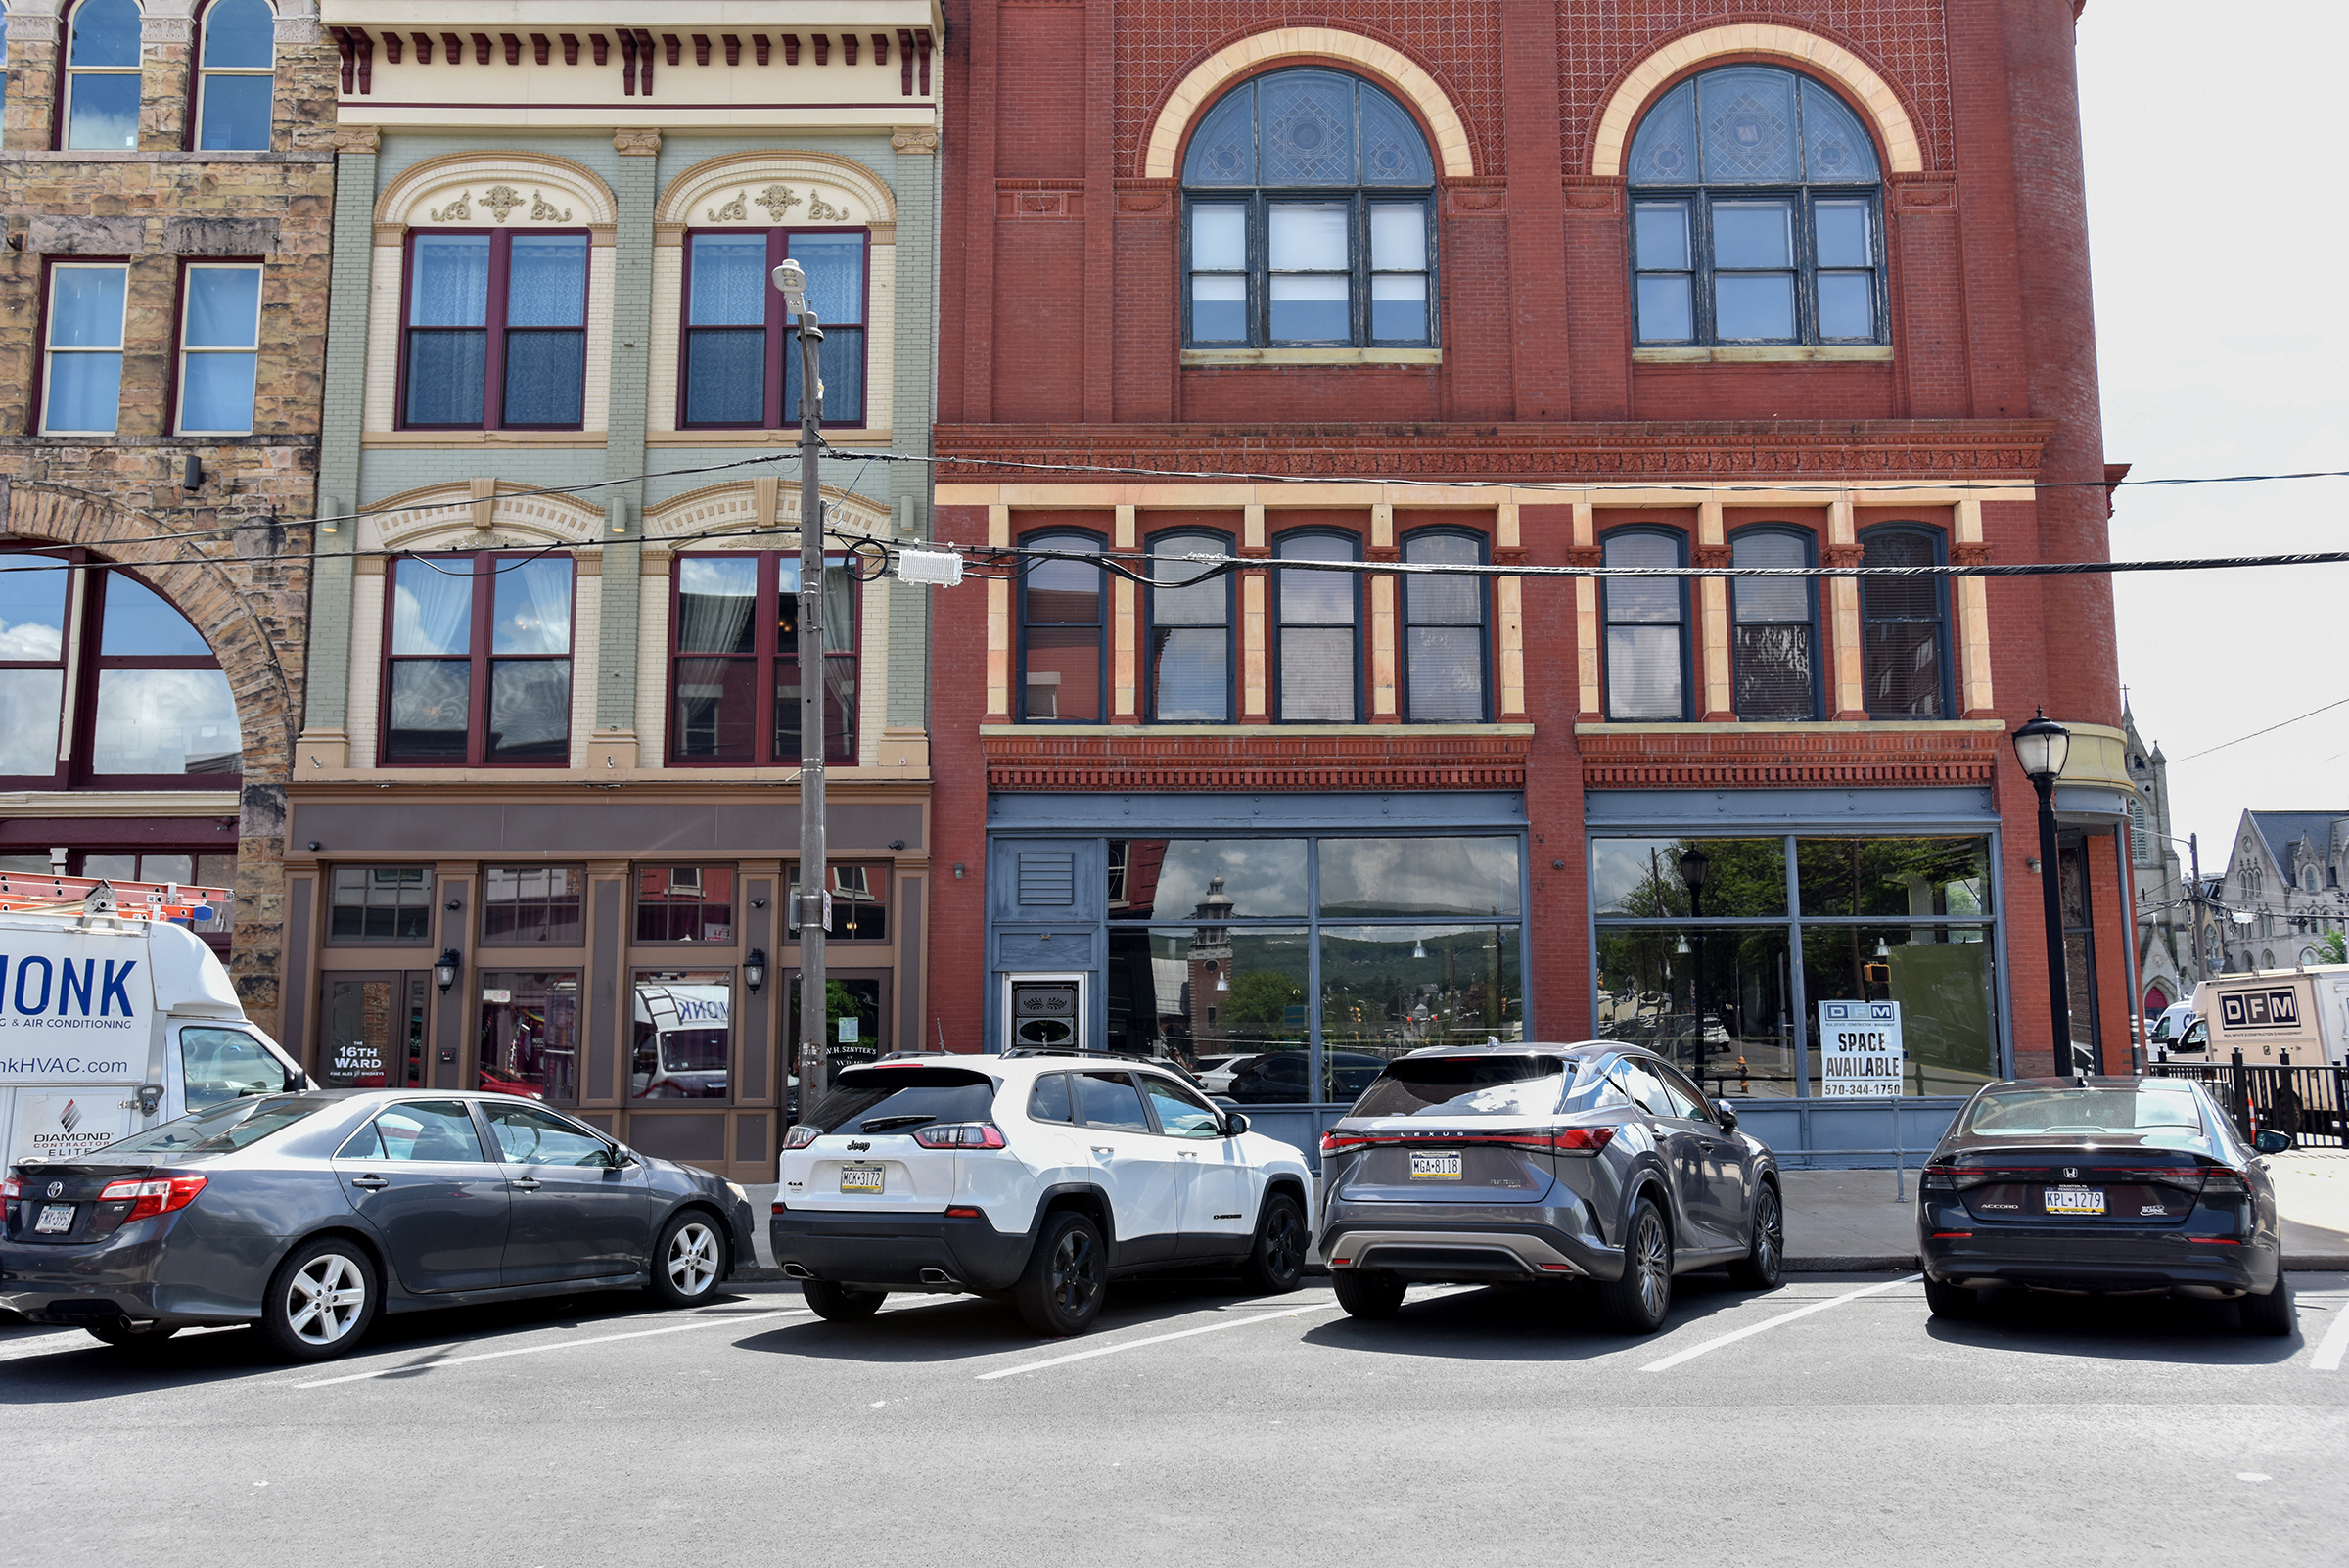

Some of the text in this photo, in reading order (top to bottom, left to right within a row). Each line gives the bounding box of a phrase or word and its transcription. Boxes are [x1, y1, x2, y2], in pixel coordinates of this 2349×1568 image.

[0, 954, 137, 1017] ONK
[1830, 1006, 1890, 1017] DFM
[2225, 996, 2294, 1020] DFM
[47, 1019, 131, 1029] CONDITIONING
[1838, 1033, 1885, 1052] SPACE
[340, 1046, 378, 1057] 16TH
[334, 1058, 383, 1069] WARD
[1826, 1057, 1900, 1077] AVAILABLE
[1825, 1084, 1900, 1095] 570-344-1750
[34, 1132, 111, 1142] DIAMOND
[33, 1140, 110, 1149] CONTRACTOR
[847, 1140, 871, 1153] Jeep
